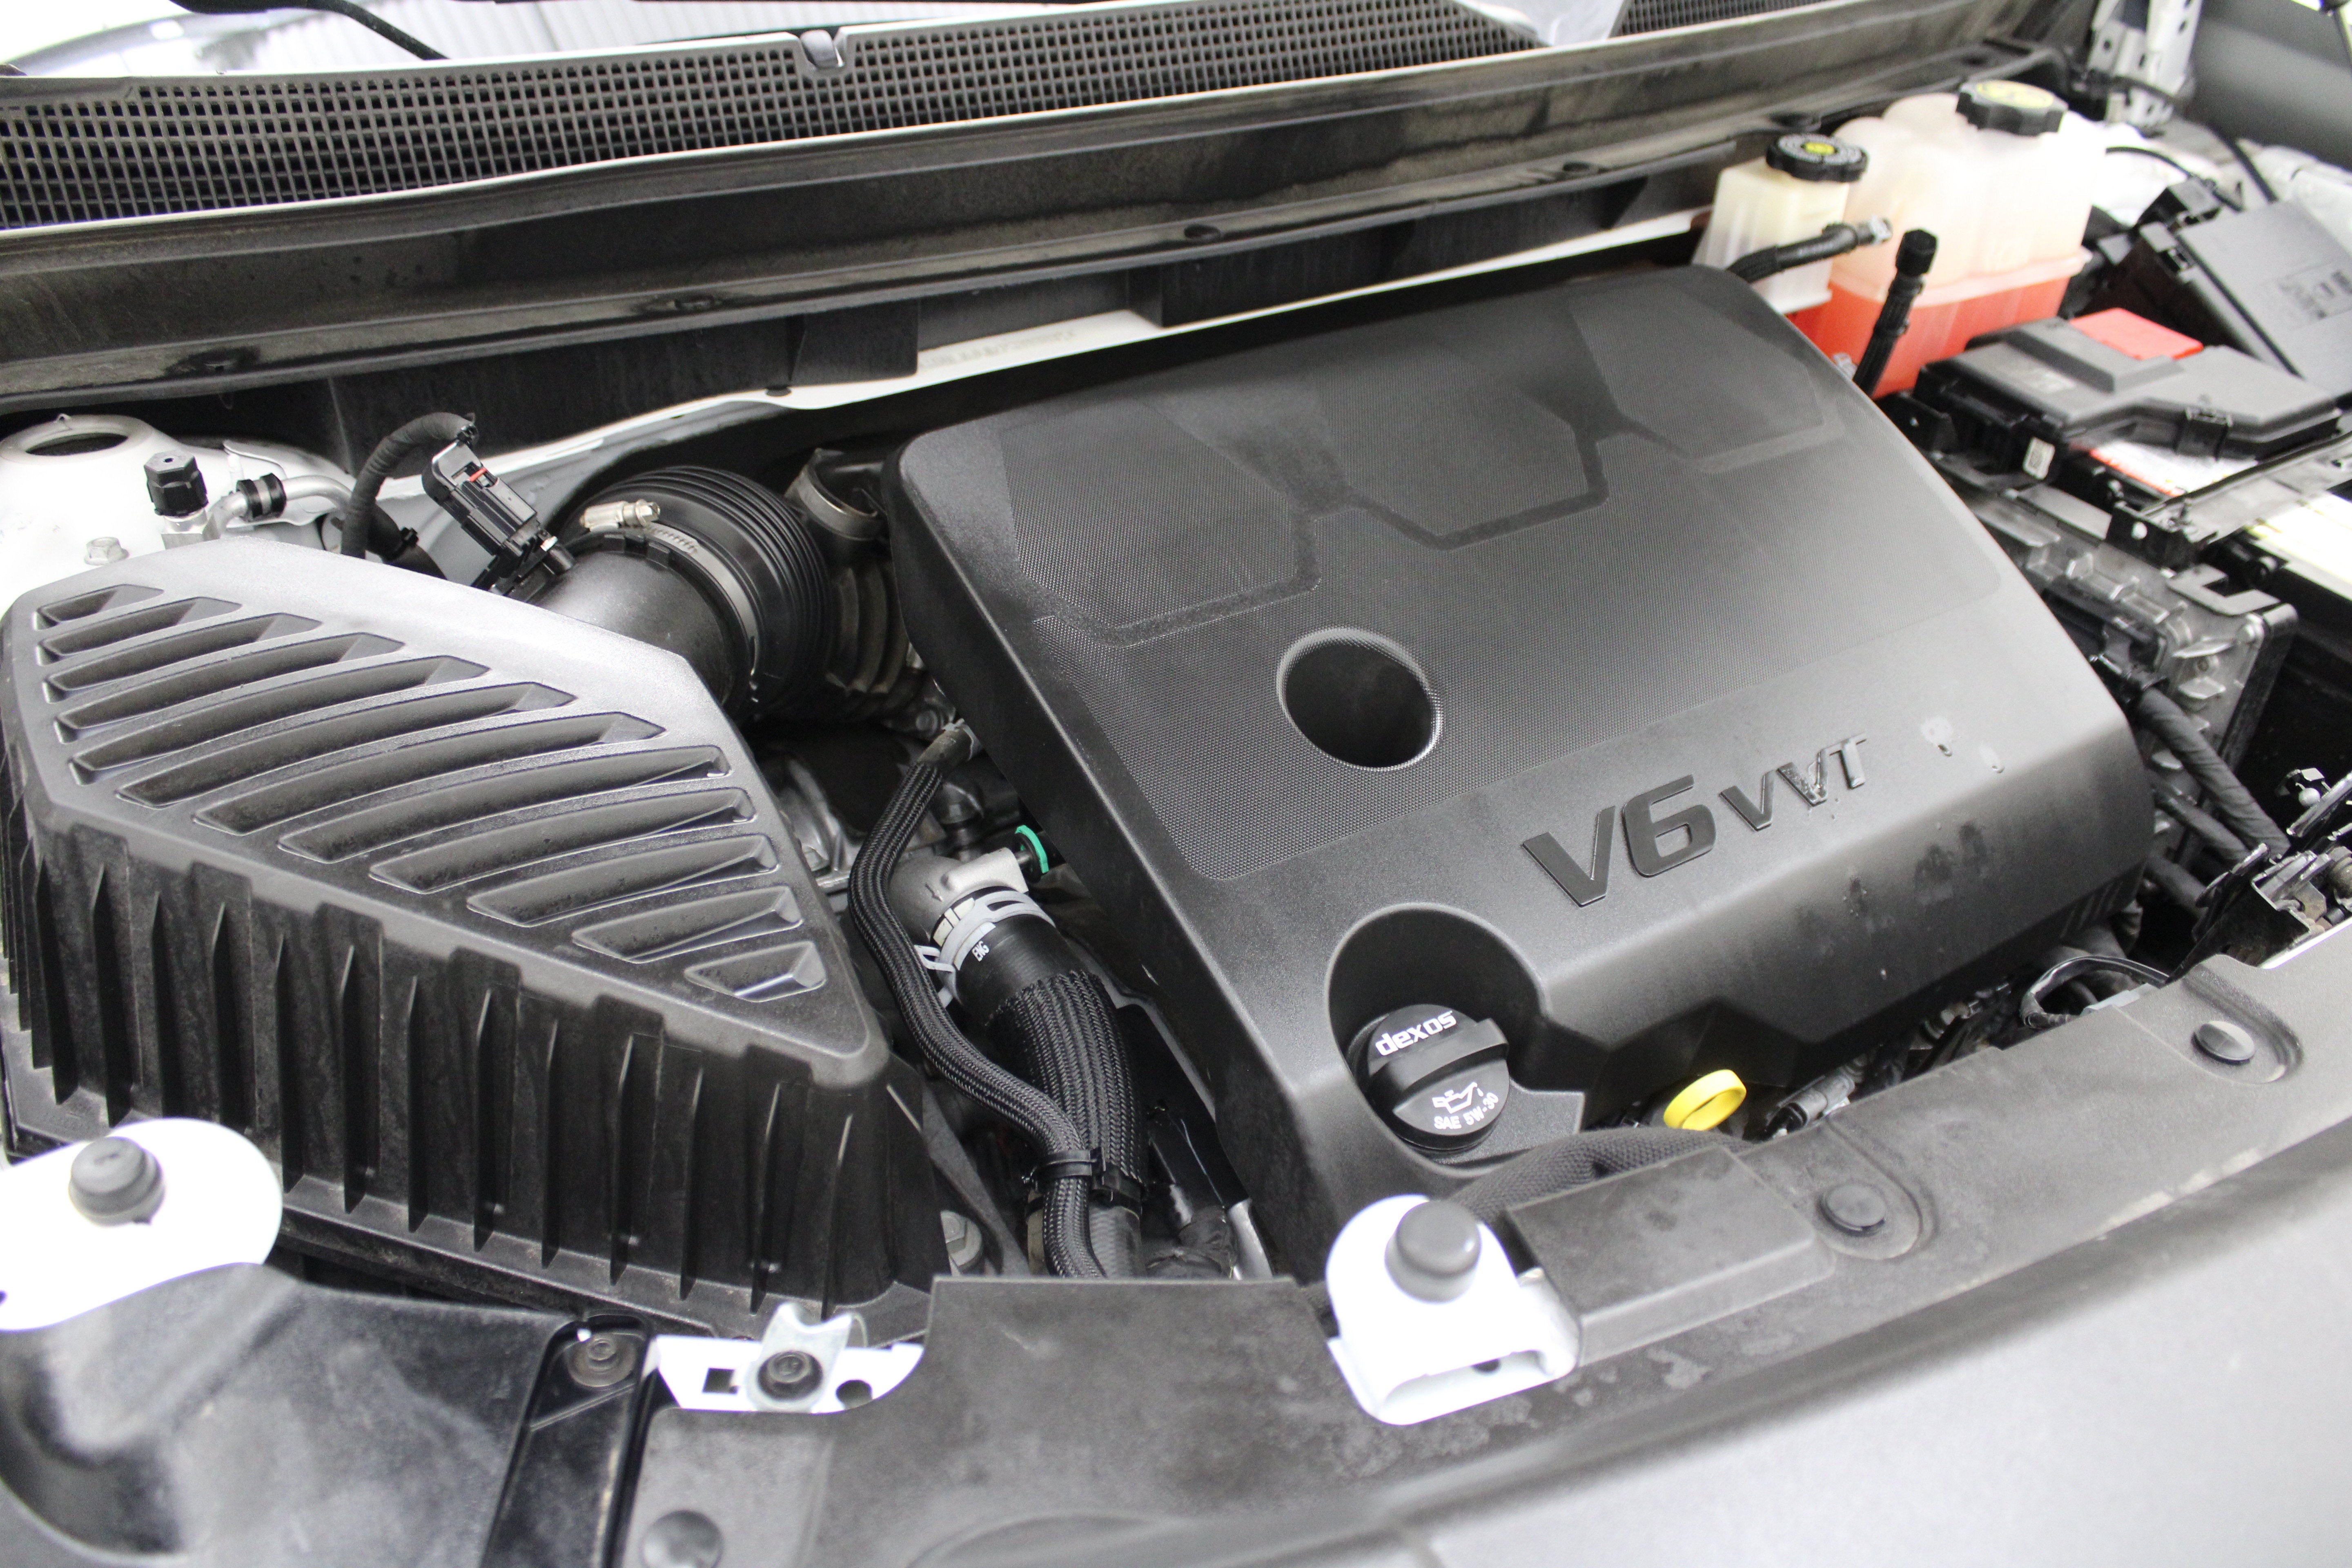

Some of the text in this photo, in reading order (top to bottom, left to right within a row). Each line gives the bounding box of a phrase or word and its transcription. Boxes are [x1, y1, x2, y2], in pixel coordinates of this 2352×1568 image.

[1520, 733, 1867, 907] V6 VVT
[972, 941, 990, 962] ENG
[1375, 1011, 1457, 1056] dexos
[1434, 1092, 1499, 1129] SAE 5W-30
